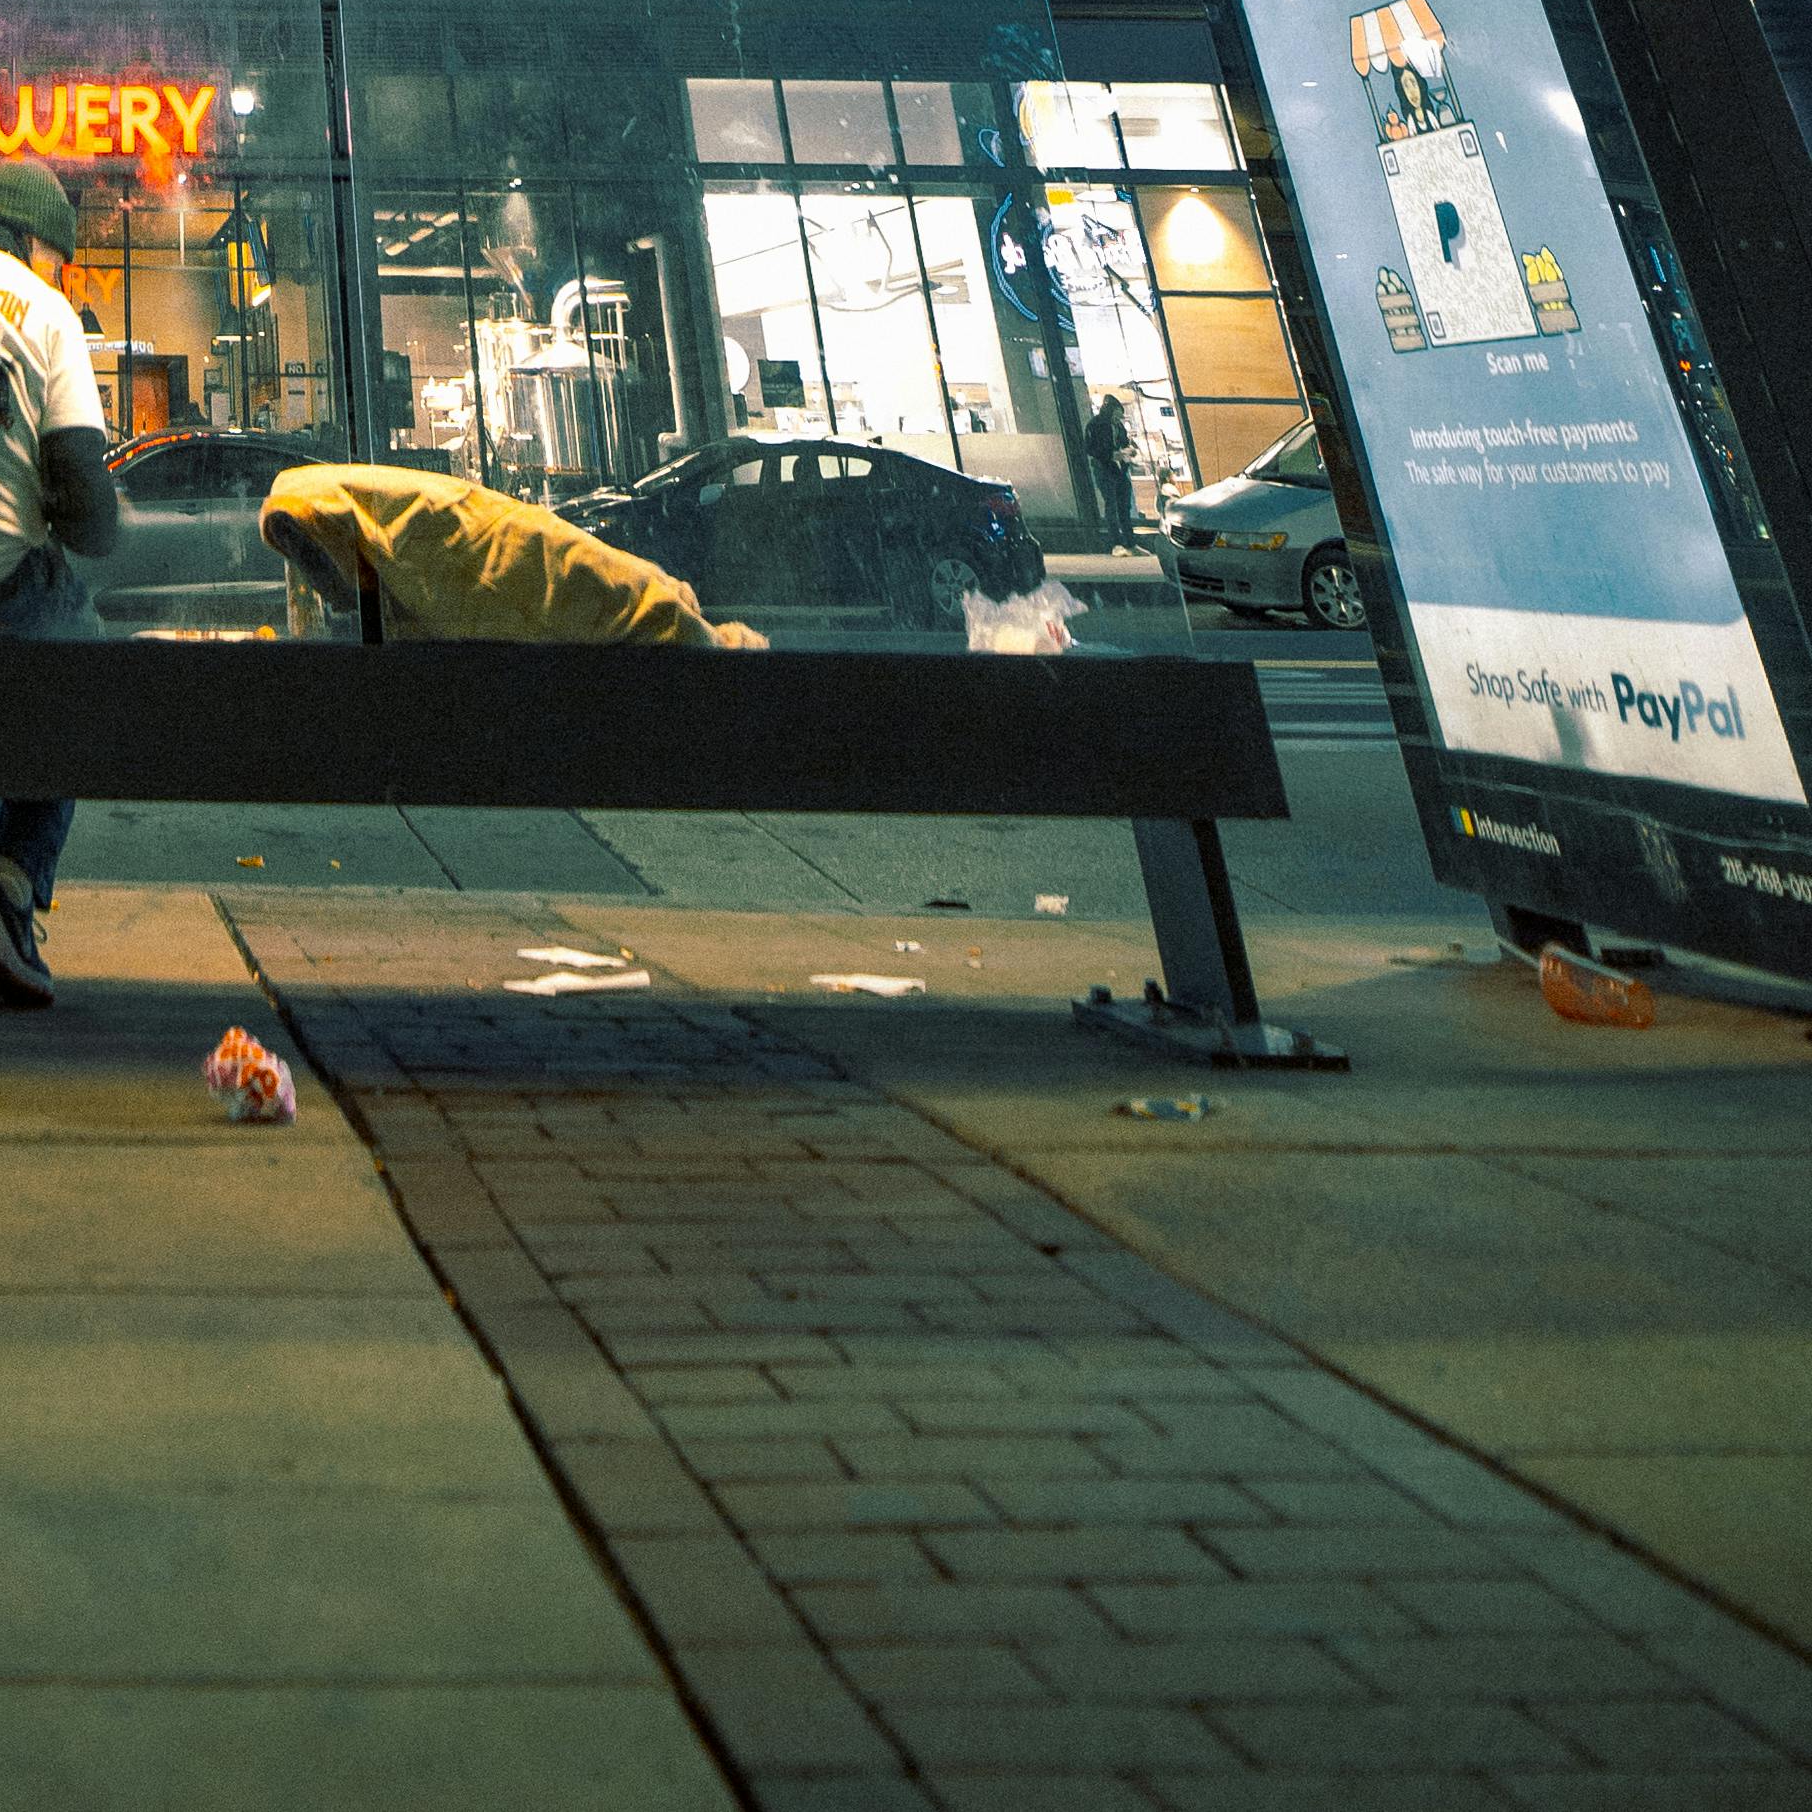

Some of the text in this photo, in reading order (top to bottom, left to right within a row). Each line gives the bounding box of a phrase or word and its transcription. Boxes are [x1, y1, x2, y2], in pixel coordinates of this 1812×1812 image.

[1486, 351, 1550, 375] Scan me
[1409, 418, 1638, 454] Introducing touch-free payments
[1404, 457, 1670, 490] The safe way for your customers to pay
[1466, 661, 1746, 744] Shop Safe with PayPal
[1473, 809, 1562, 857] Intersection
